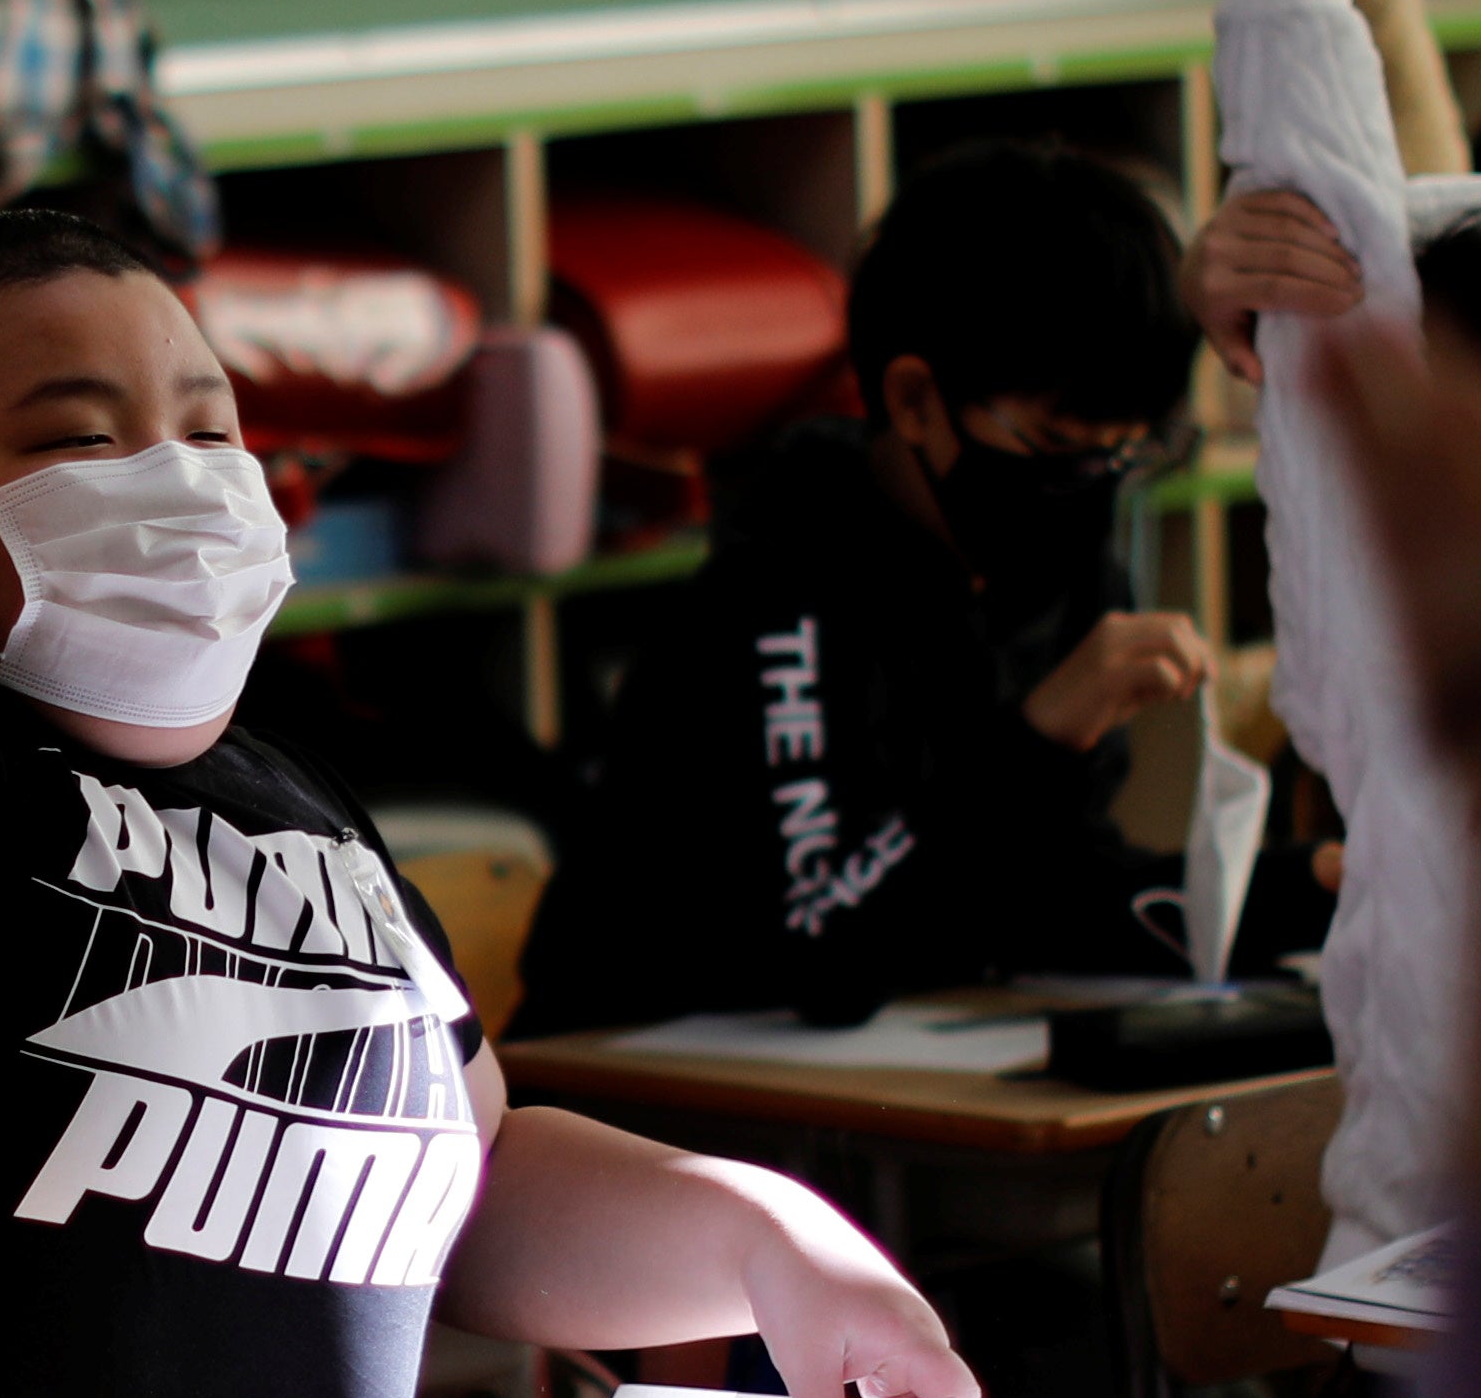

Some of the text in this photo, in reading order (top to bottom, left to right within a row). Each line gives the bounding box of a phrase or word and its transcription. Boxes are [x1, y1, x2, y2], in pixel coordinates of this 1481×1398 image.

[755, 616, 825, 768] THE
[67, 770, 407, 972] PUM
[13, 1070, 482, 1288] PUMA
